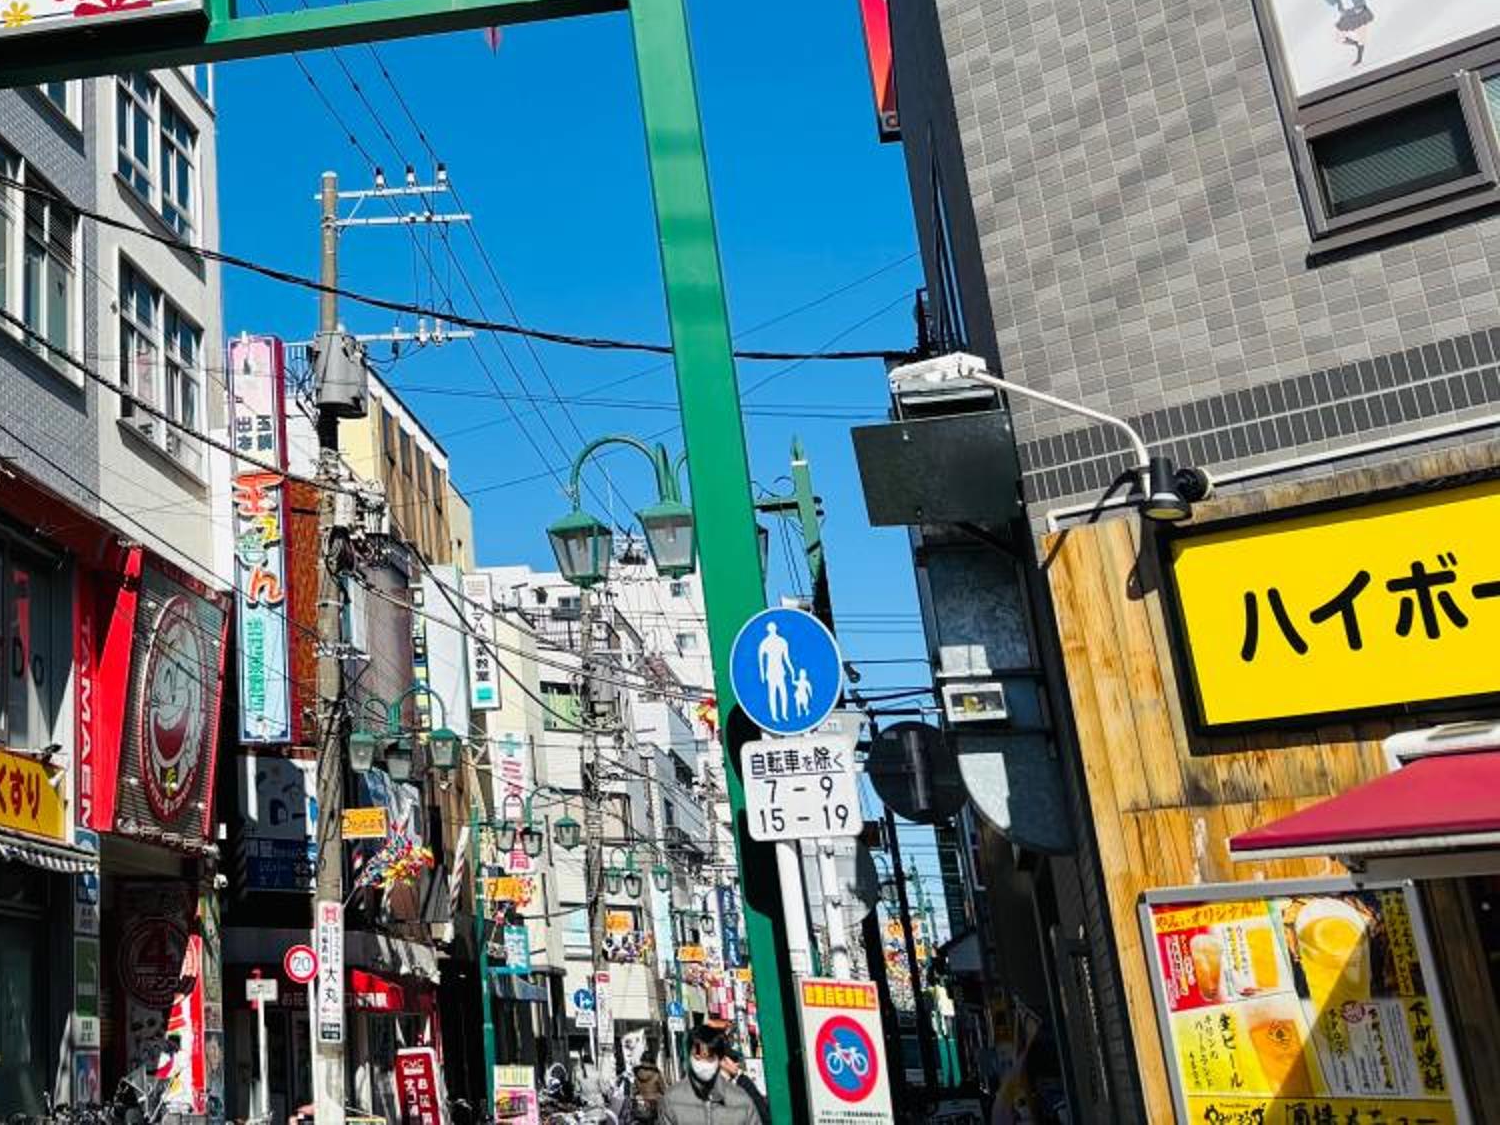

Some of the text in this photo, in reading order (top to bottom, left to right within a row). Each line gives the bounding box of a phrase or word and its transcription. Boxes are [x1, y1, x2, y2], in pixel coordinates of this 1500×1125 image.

[750, 745, 846, 775] 自転車を除く
